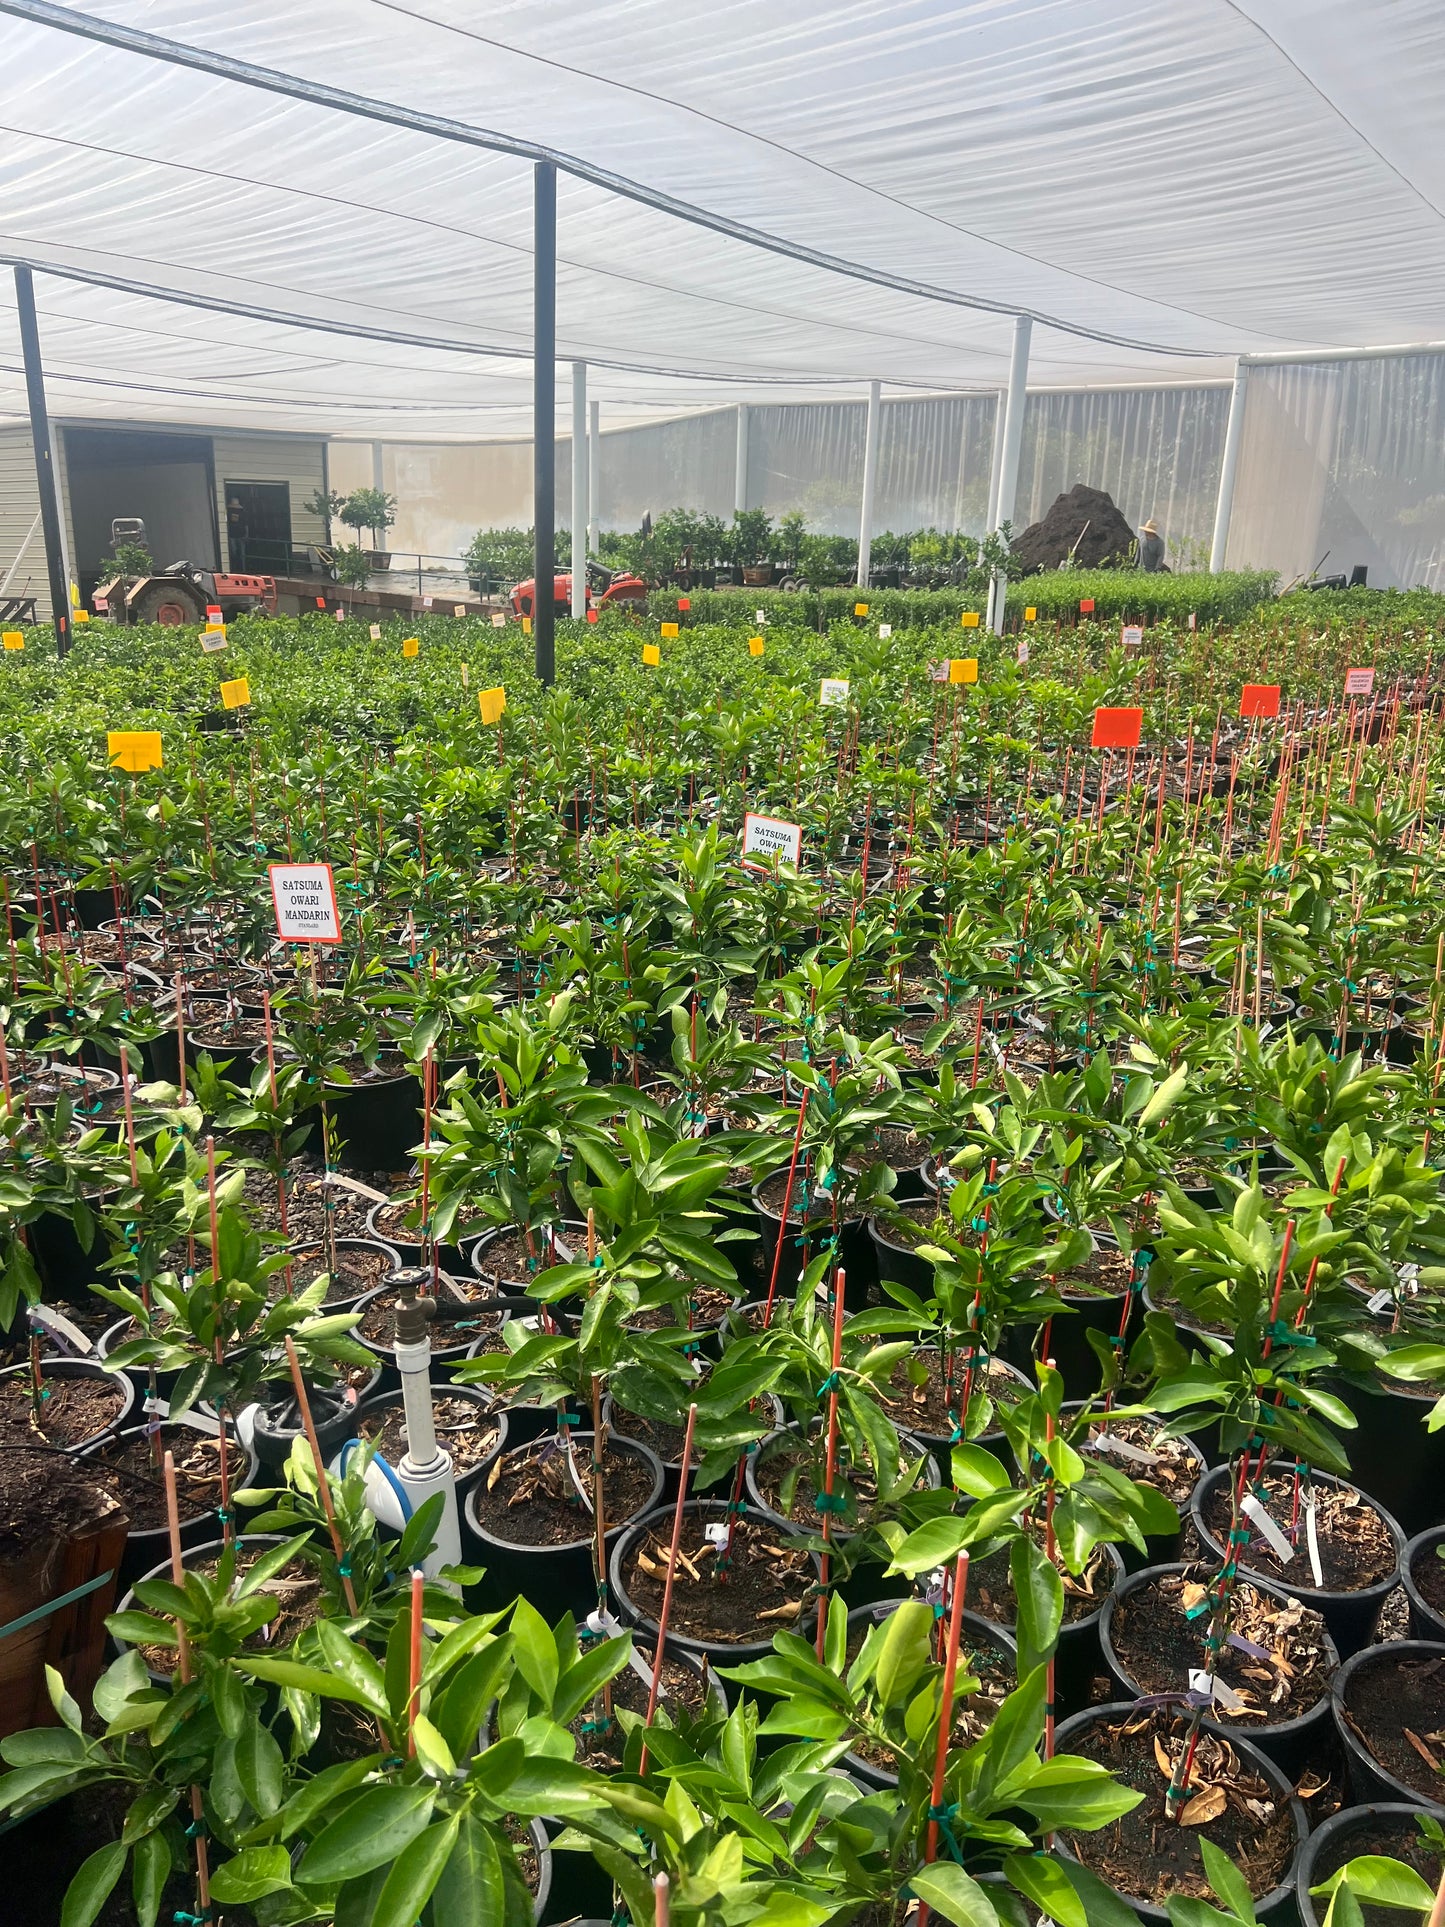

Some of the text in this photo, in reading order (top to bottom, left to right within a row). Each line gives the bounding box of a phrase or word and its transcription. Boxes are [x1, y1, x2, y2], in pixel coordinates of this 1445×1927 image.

[754, 826, 792, 842] SATSUMA
[759, 838, 786, 852] OWARI
[752, 847, 793, 862] MANRIN
[282, 880, 323, 891] SATSUMA
[290, 895, 320, 906] OWARI
[285, 910, 330, 921] MANDARIN
